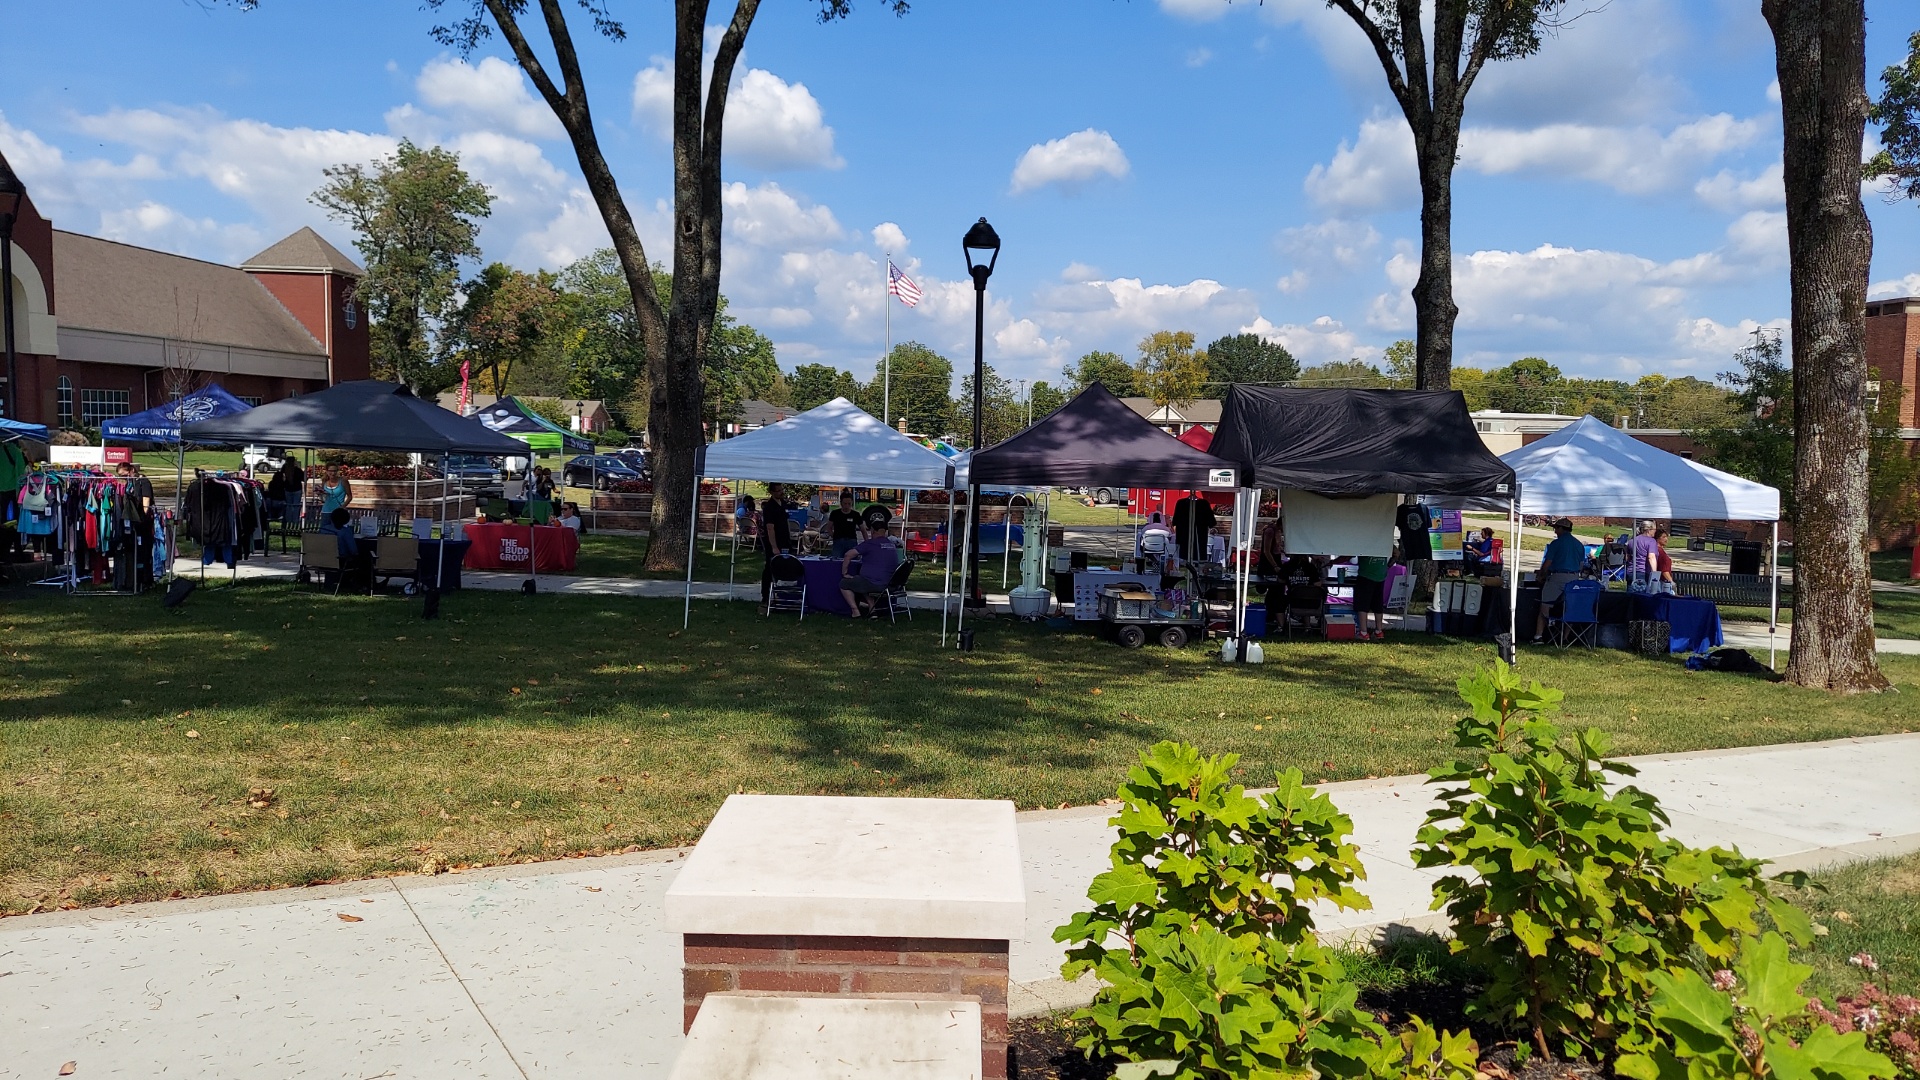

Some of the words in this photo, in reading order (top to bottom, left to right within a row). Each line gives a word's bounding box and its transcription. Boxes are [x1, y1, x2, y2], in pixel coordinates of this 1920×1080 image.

[108, 427, 138, 435] WILSON
[140, 428, 169, 436] COUNTY
[501, 538, 517, 547] THE
[500, 553, 528, 561] GROUP
